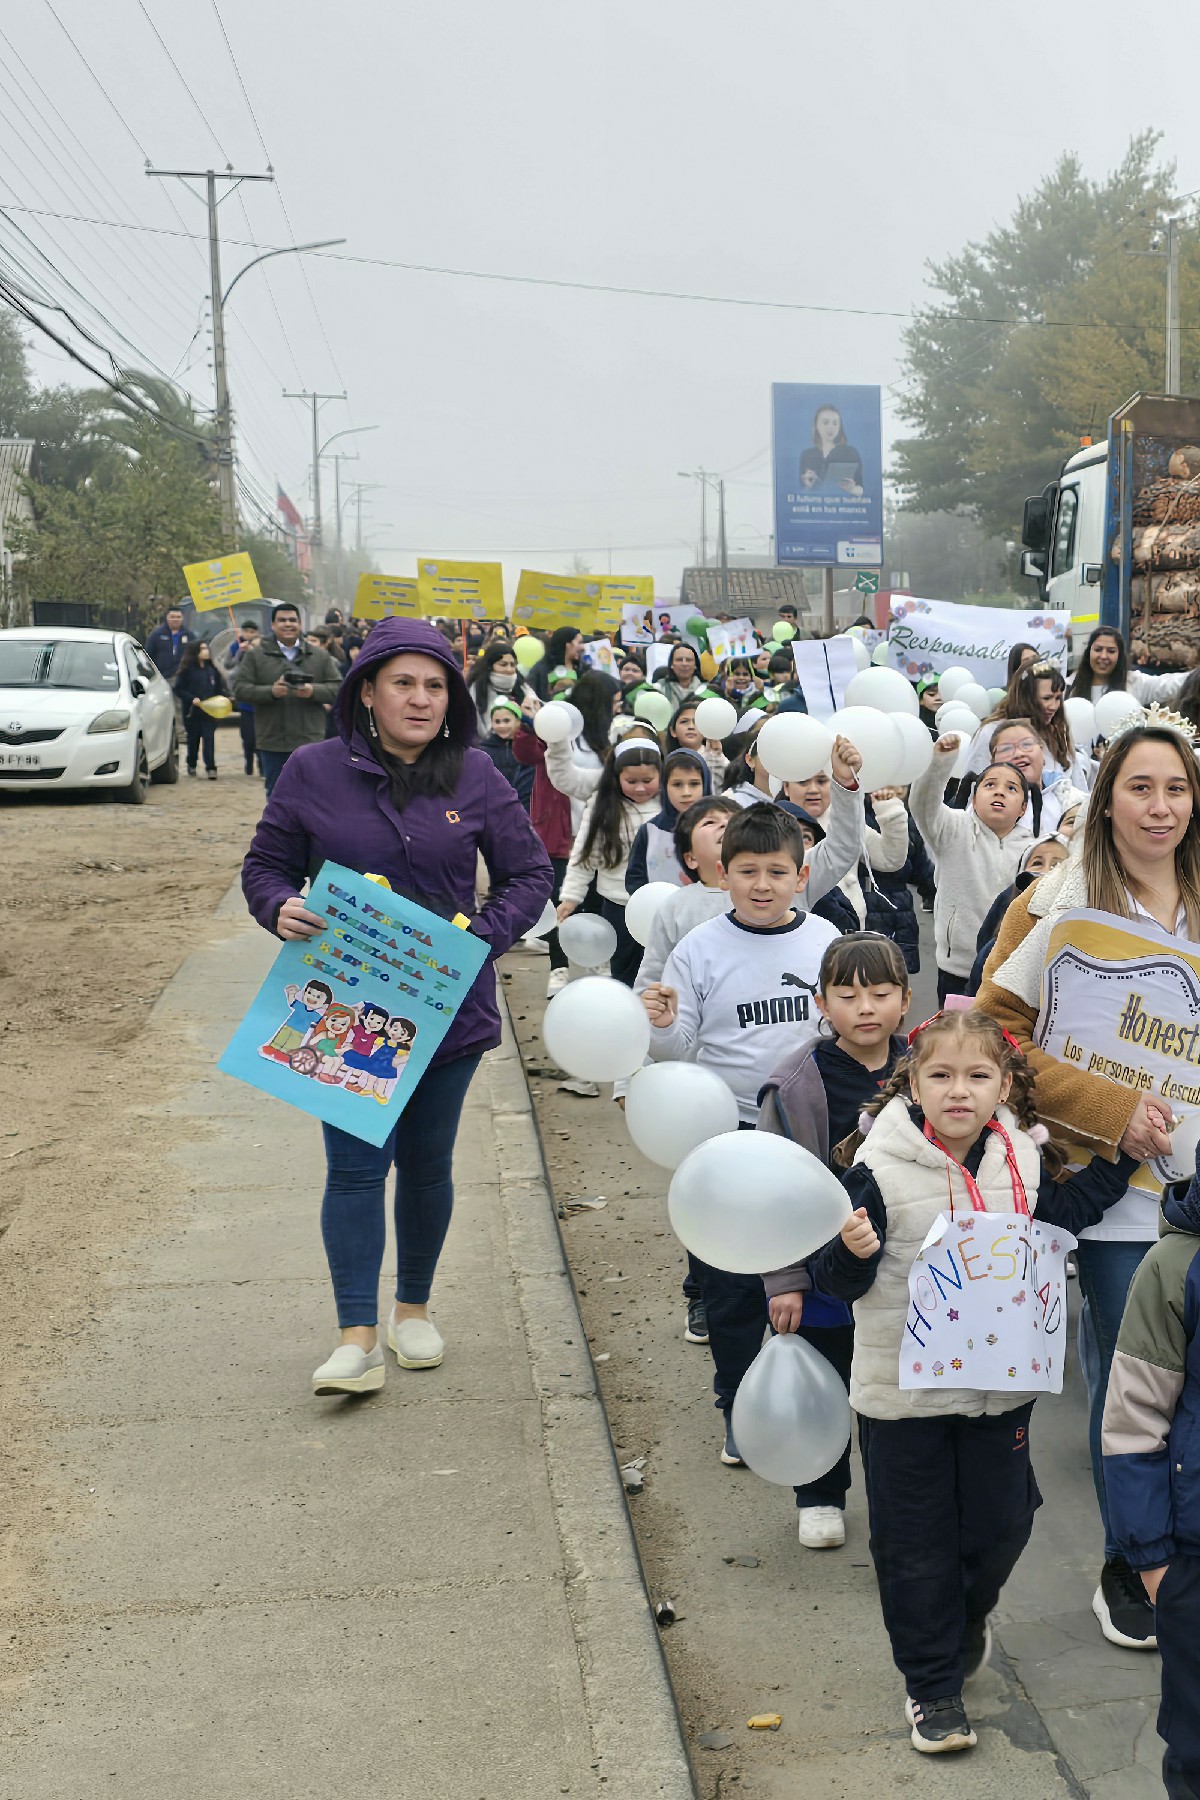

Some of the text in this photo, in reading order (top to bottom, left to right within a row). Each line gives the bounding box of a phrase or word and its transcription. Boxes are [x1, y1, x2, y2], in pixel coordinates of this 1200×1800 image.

[889, 625, 1067, 663] Responsabiad
[362, 903, 433, 947] PERSONA
[736, 995, 809, 1029] PUMA
[1063, 1037, 1083, 1062] Los
[1088, 1052, 1154, 1090] personajes
[907, 1235, 1062, 1348] HONESTAD
